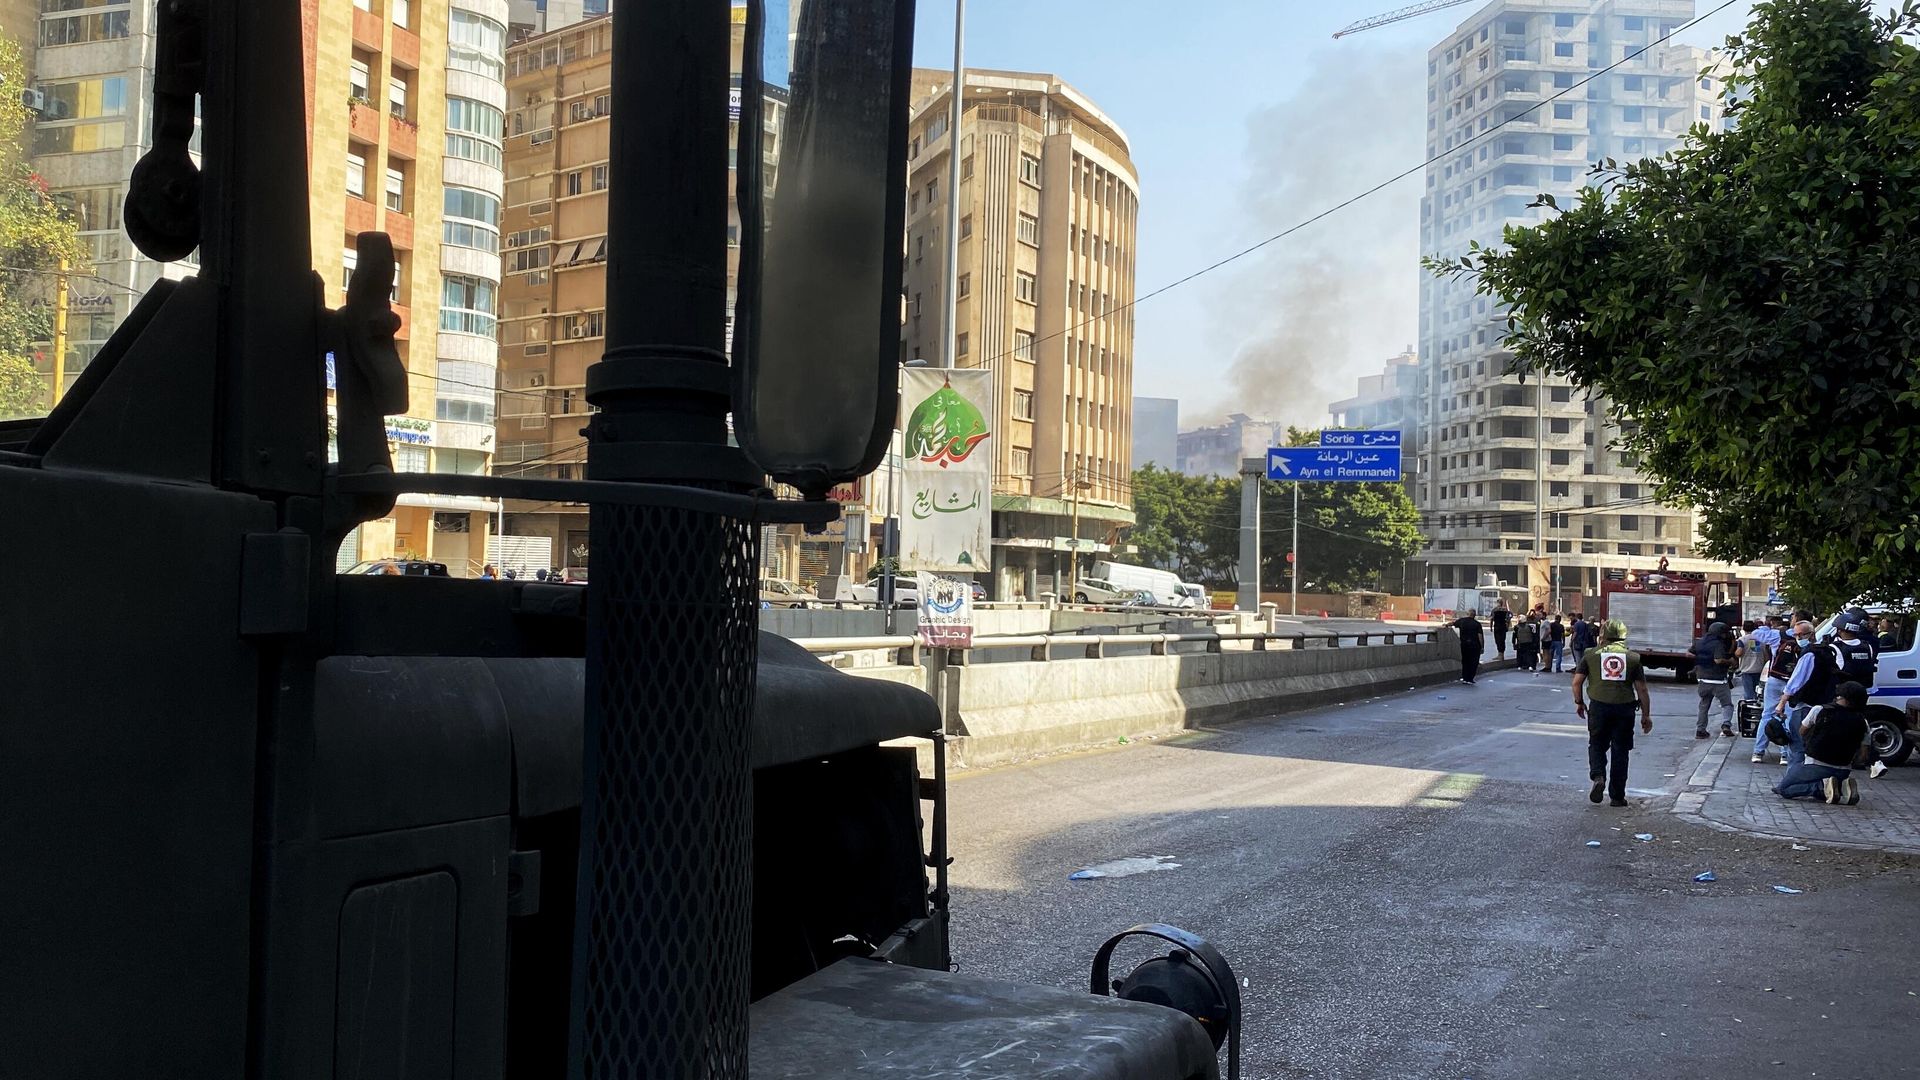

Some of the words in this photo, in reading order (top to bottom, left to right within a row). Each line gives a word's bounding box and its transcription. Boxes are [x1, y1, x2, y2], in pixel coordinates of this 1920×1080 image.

[1325, 434, 1355, 444] Sortie
[1317, 450, 1353, 464] الرمانة
[1355, 453, 1380, 464] عين
[1300, 467, 1319, 478] Ayn
[1324, 466, 1334, 476] el
[1337, 466, 1396, 477] Remmaneh
[911, 488, 982, 520] المشاريع
[919, 615, 946, 624] Graphic
[947, 616, 971, 625] Design
